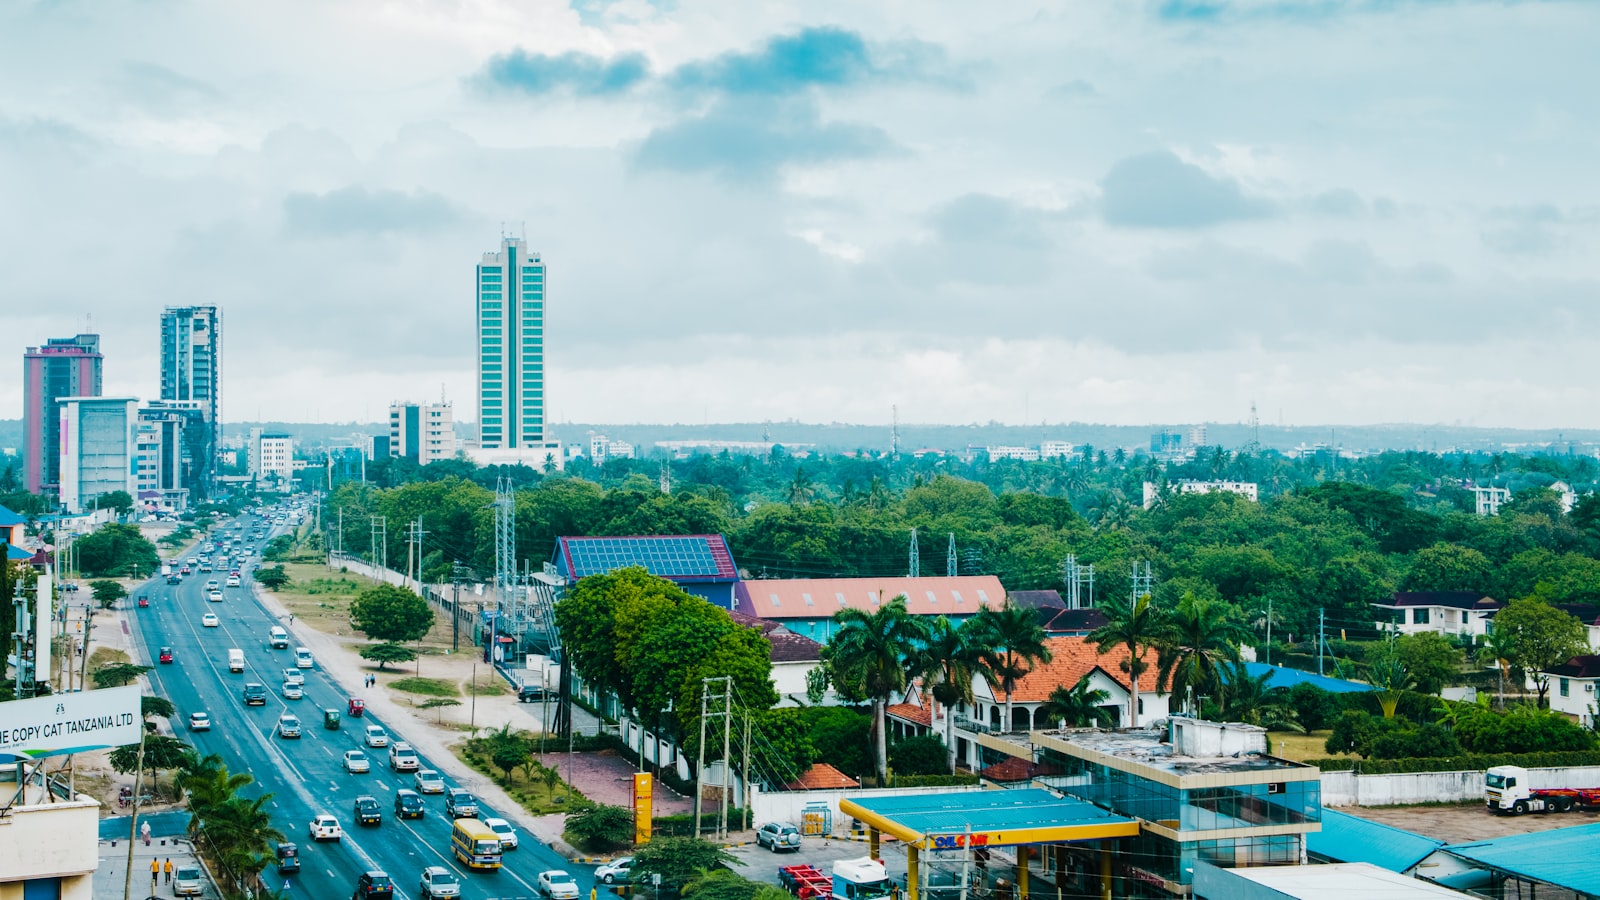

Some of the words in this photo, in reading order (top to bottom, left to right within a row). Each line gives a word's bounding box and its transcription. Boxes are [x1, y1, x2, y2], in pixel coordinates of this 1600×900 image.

[0, 730, 9, 744] E
[12, 726, 41, 742] COPY
[43, 722, 63, 737] CAT
[65, 715, 114, 734] TANZANIA
[116, 712, 133, 727] LTD
